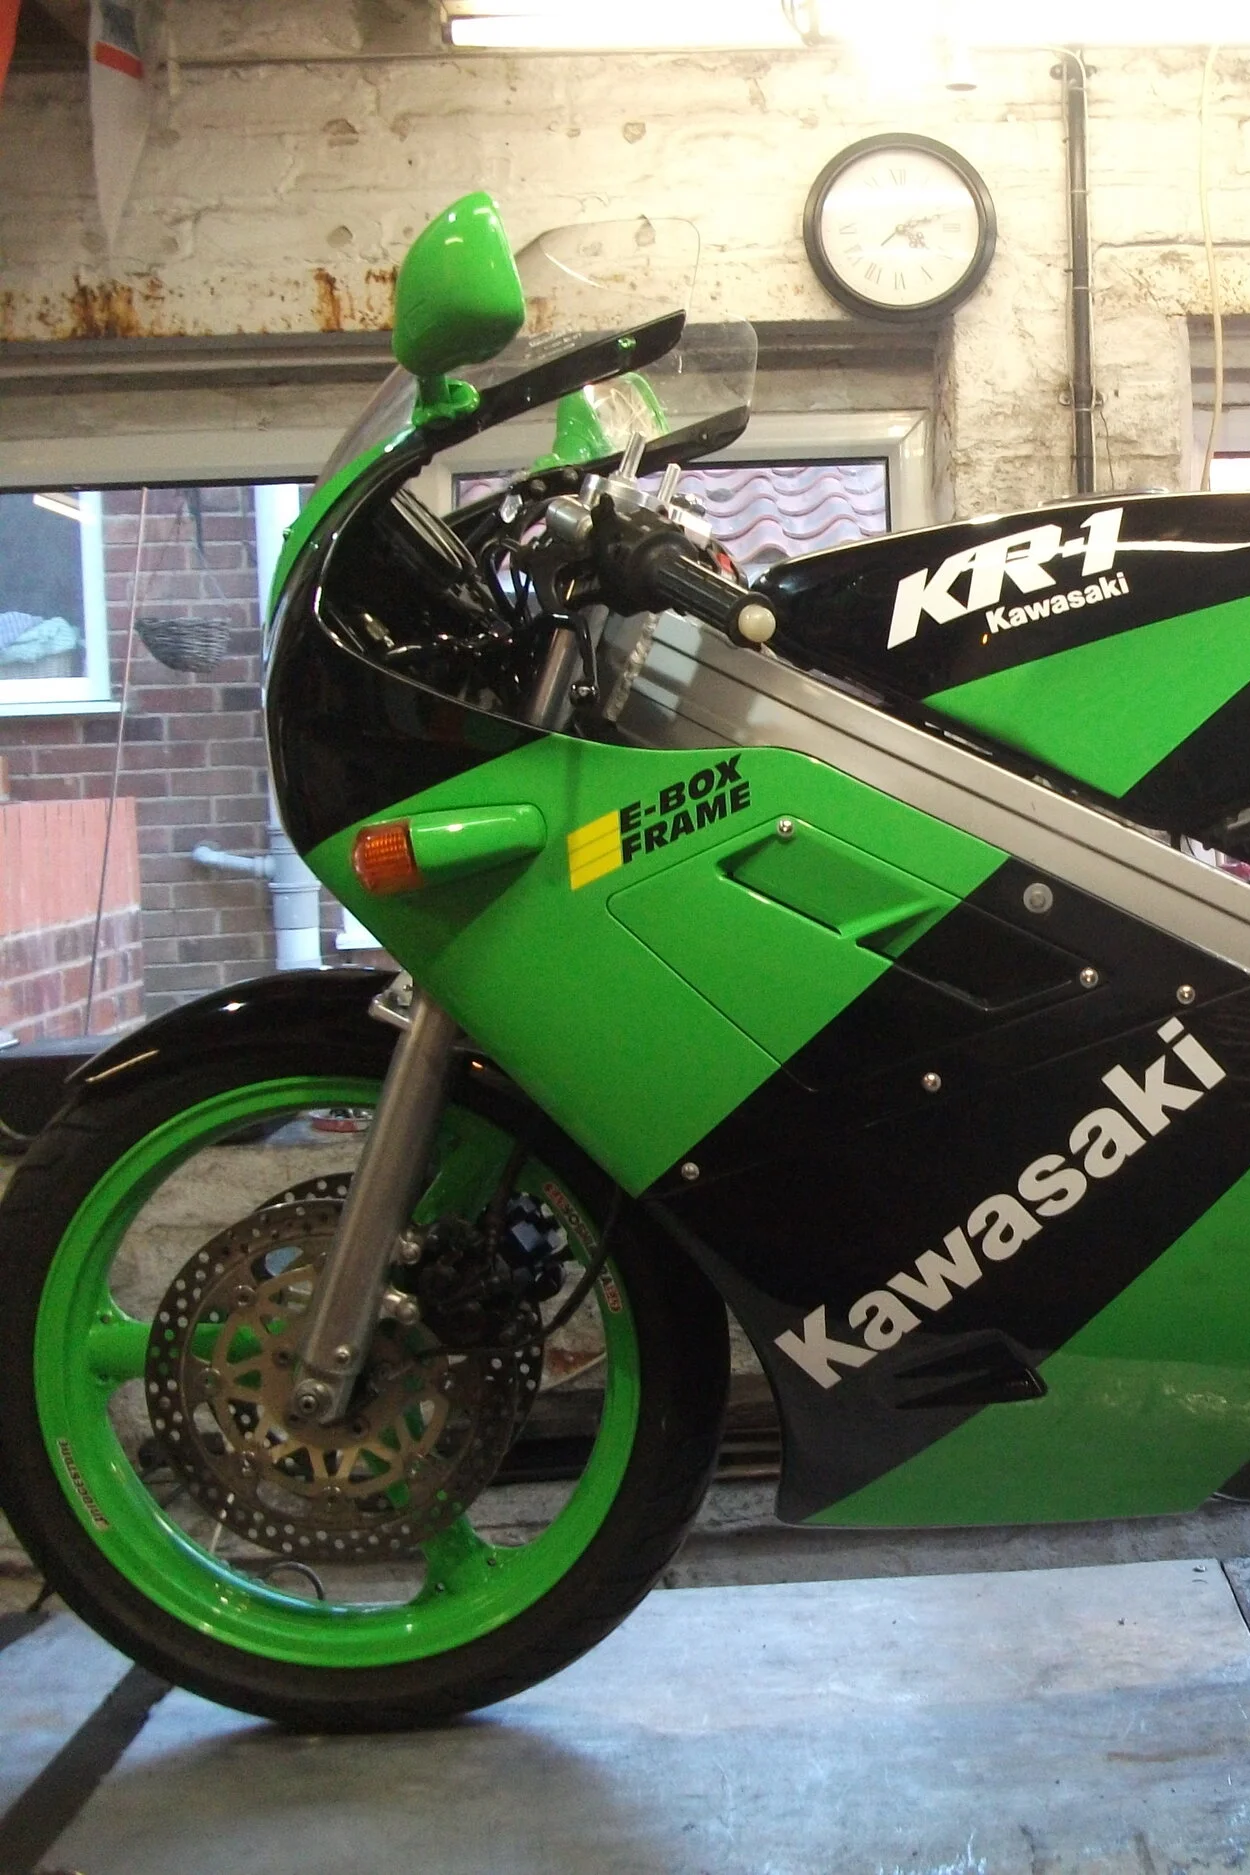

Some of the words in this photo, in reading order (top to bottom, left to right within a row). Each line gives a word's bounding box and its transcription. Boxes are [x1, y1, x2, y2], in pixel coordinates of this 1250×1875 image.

[985, 571, 1129, 633] Kawasaki
[620, 754, 742, 833] E-BOX
[622, 781, 750, 865] FRAME
[773, 1016, 1227, 1390] Kawasaki
